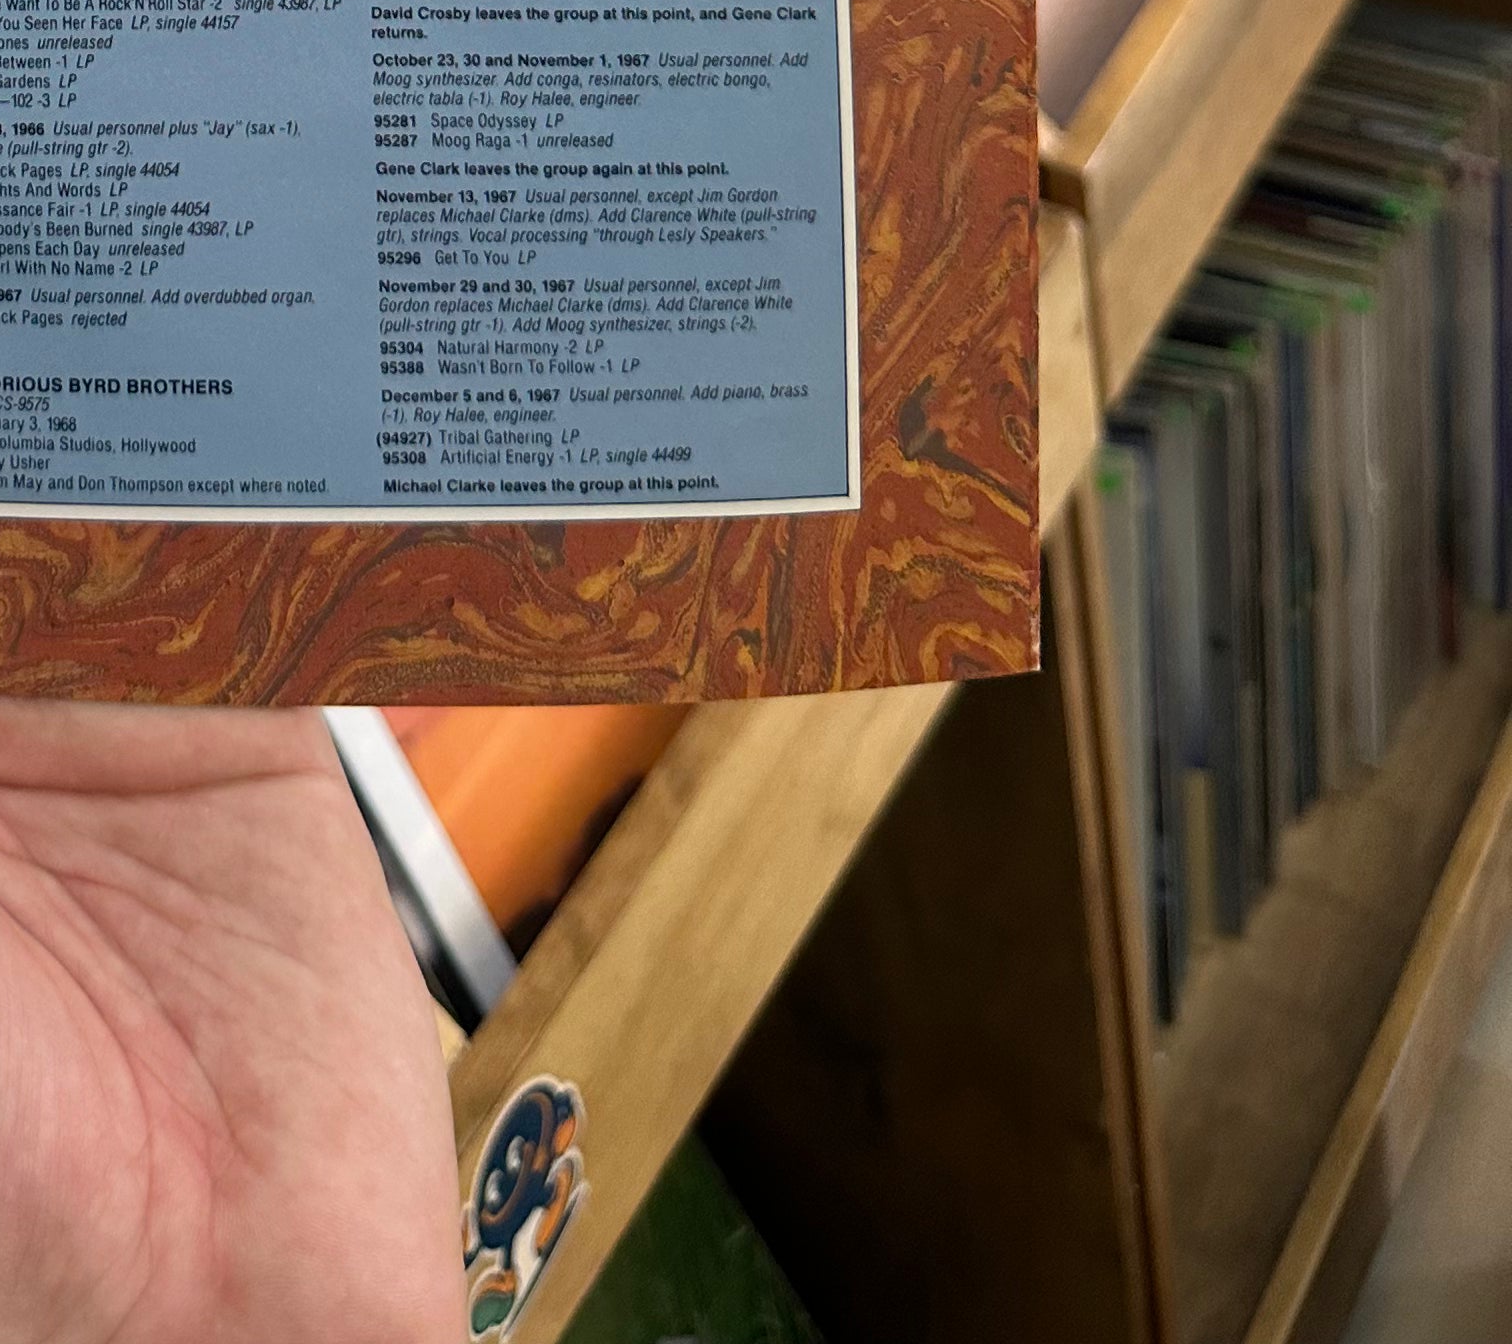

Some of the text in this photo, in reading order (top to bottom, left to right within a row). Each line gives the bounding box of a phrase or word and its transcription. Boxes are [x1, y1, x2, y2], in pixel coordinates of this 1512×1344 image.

[371, 6, 816, 23] David Crosby leaves the group at this point, and Gene Clark
[37, 34, 113, 49] unreleased
[373, 112, 563, 130] 95281 Space Odyssey LP
[68, 377, 120, 393] BYRD
[126, 378, 232, 395] BROTHERS
[383, 475, 719, 494] Michael Clarke leaves the group at this point.
